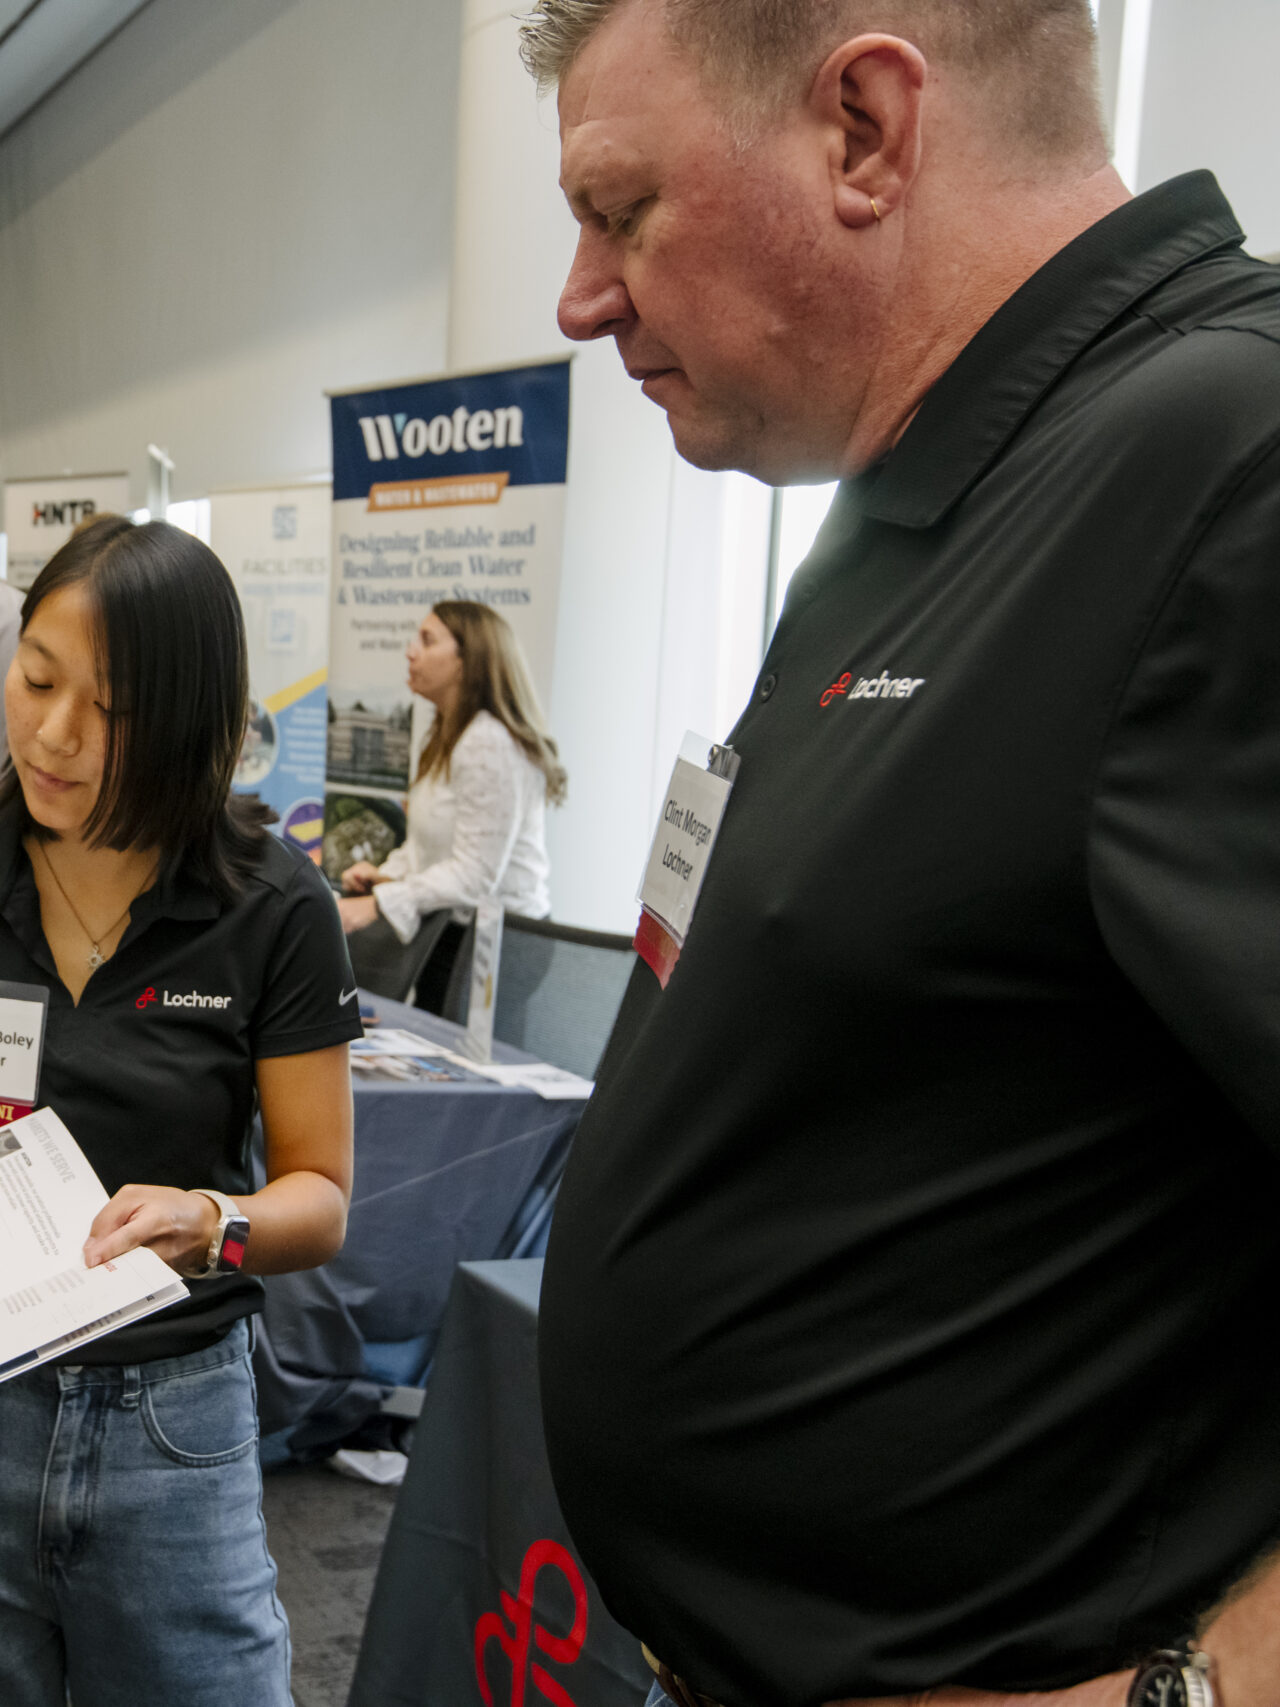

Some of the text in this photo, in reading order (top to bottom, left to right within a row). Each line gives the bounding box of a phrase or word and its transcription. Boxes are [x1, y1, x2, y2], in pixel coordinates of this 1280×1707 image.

[359, 405, 524, 462] Wooten
[339, 523, 536, 555] Designing Reliable and
[343, 554, 525, 579] Resilient Clean Water
[847, 669, 925, 700] Lochner
[664, 799, 712, 846] Clint Morgan
[662, 843, 693, 881] Lochner
[163, 990, 232, 1009] Lochner
[48, 1152, 76, 1184] SERVE
